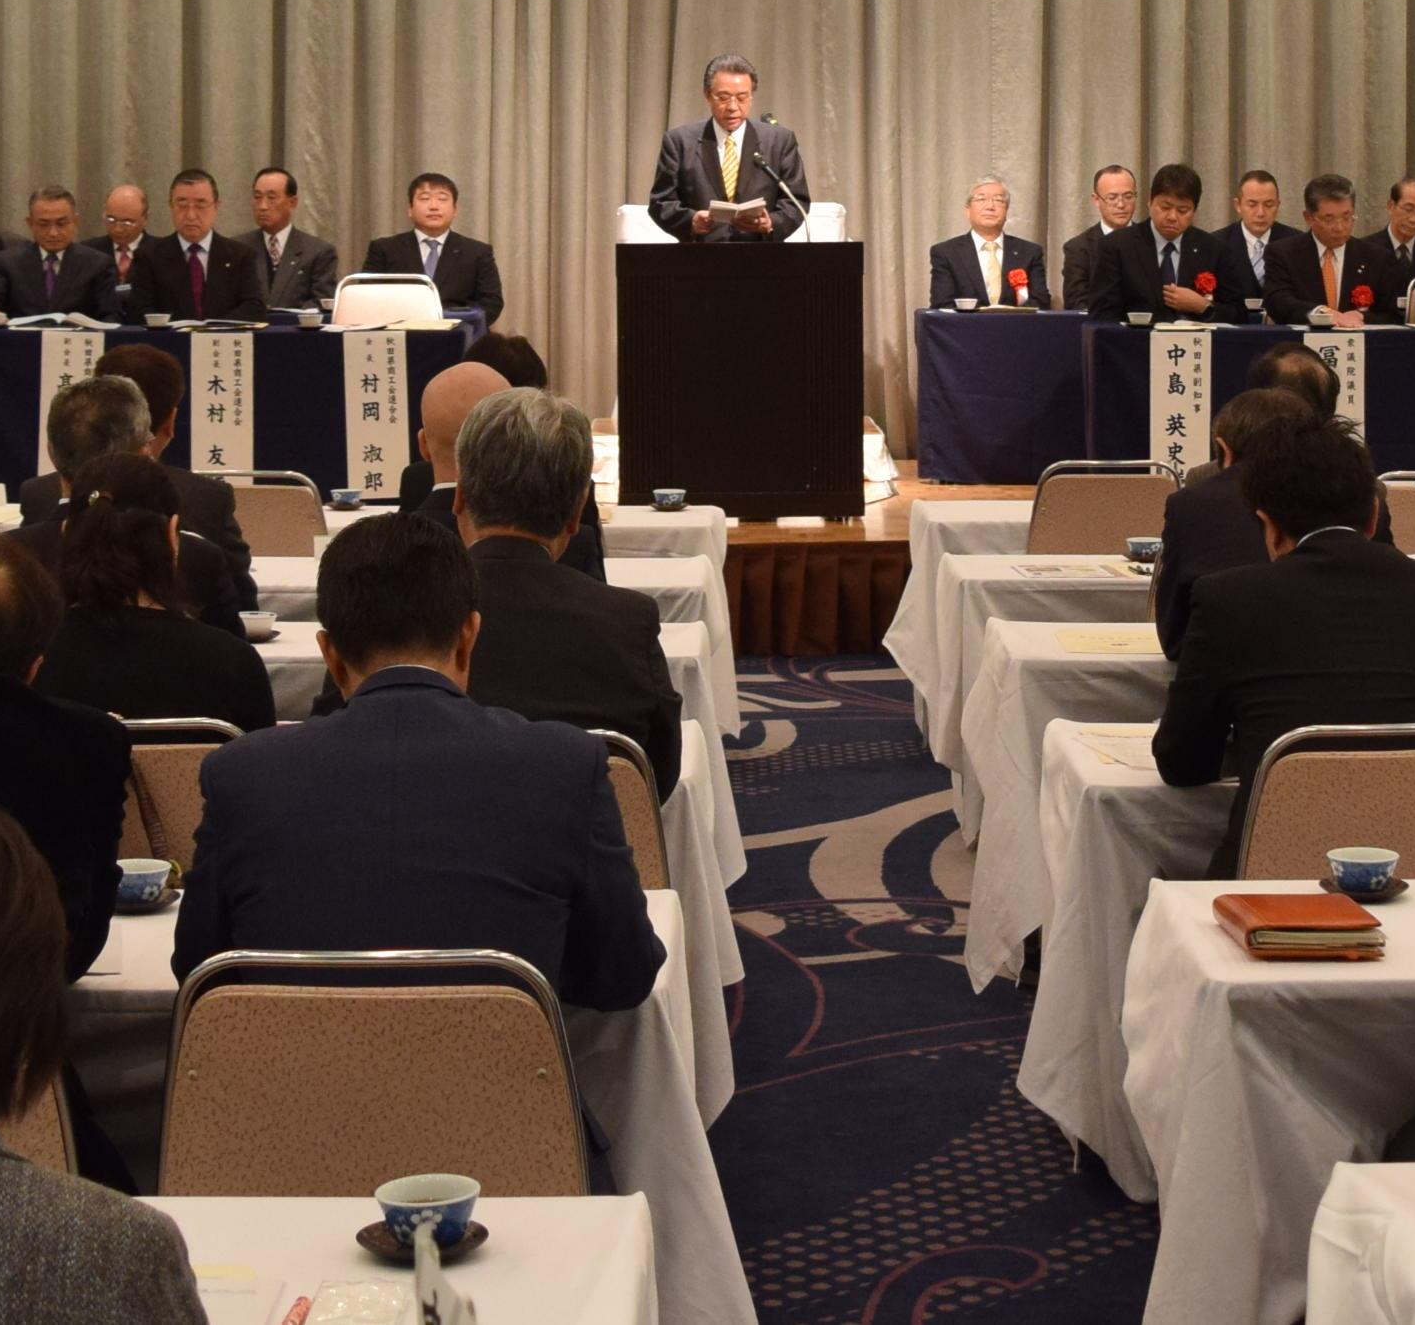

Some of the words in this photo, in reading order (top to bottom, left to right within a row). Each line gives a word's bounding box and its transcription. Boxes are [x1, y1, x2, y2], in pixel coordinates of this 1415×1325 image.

[233, 339, 242, 427] 秋田県商工会連合会
[386, 337, 397, 424] 秋田県商工会連合会
[1166, 344, 1186, 396] 中島
[1193, 337, 1202, 413] 秋田県副知事
[206, 374, 227, 423] 木村
[361, 373, 380, 421] 村岡
[362, 443, 384, 492] 淑郎
